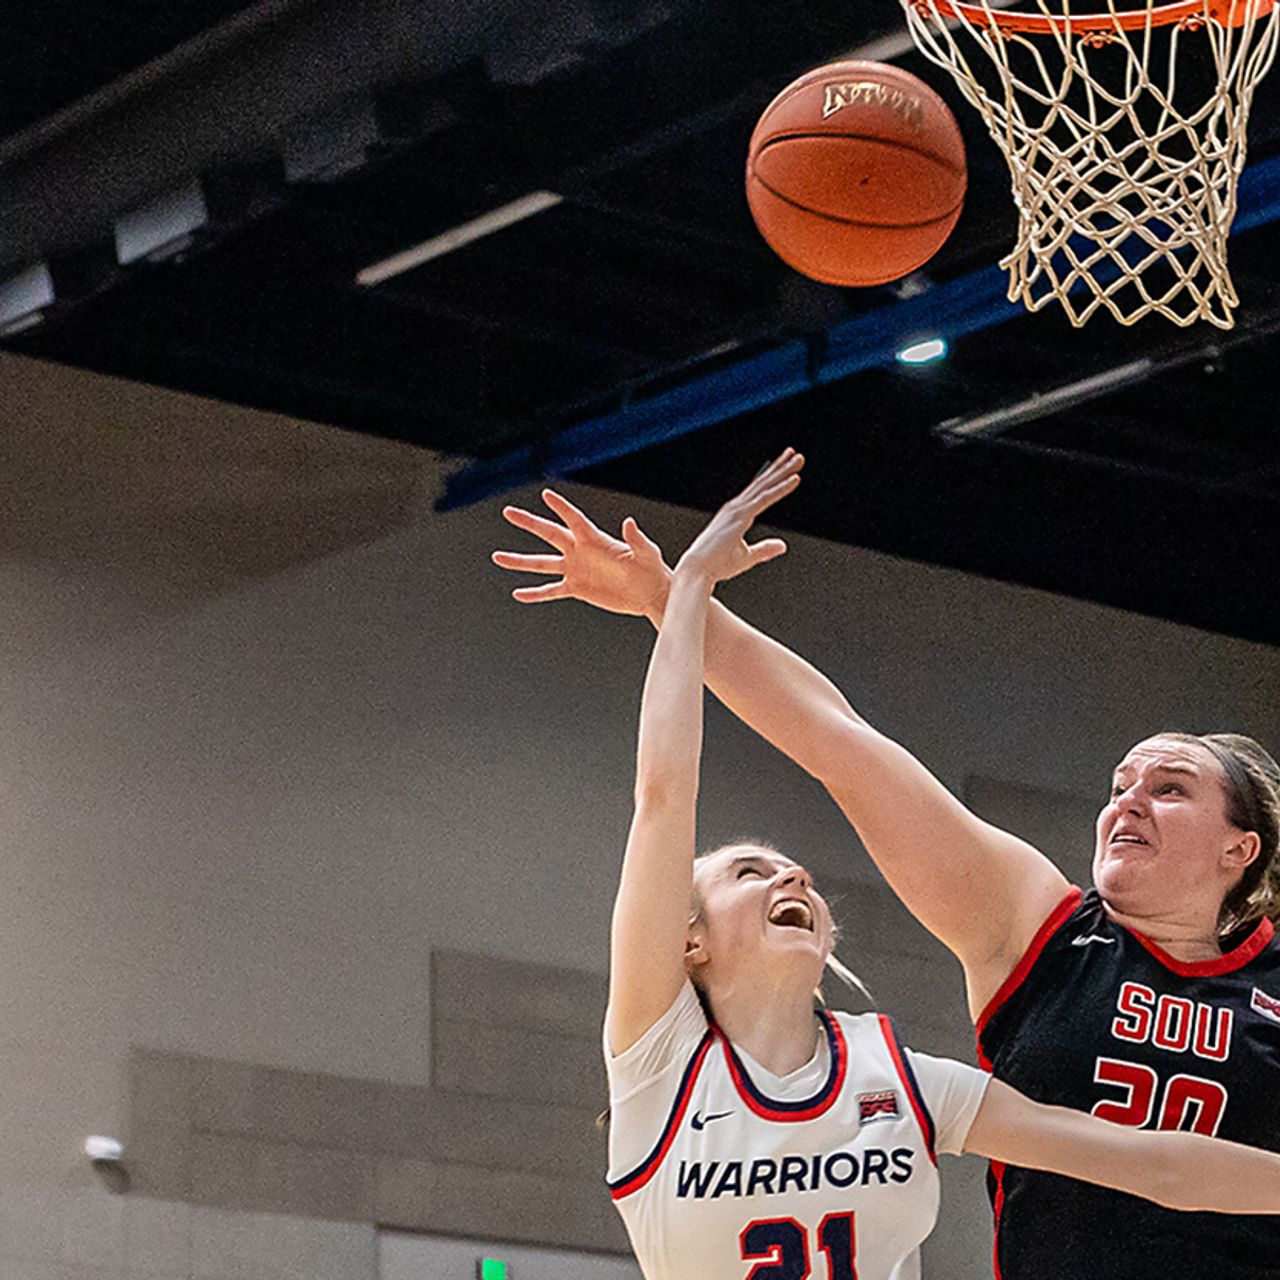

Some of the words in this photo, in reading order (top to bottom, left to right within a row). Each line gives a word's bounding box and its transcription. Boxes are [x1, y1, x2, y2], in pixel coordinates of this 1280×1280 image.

[1111, 981, 1234, 1062] SOU
[1090, 1056, 1228, 1137] 20
[676, 1148, 914, 1198] WARRIORS
